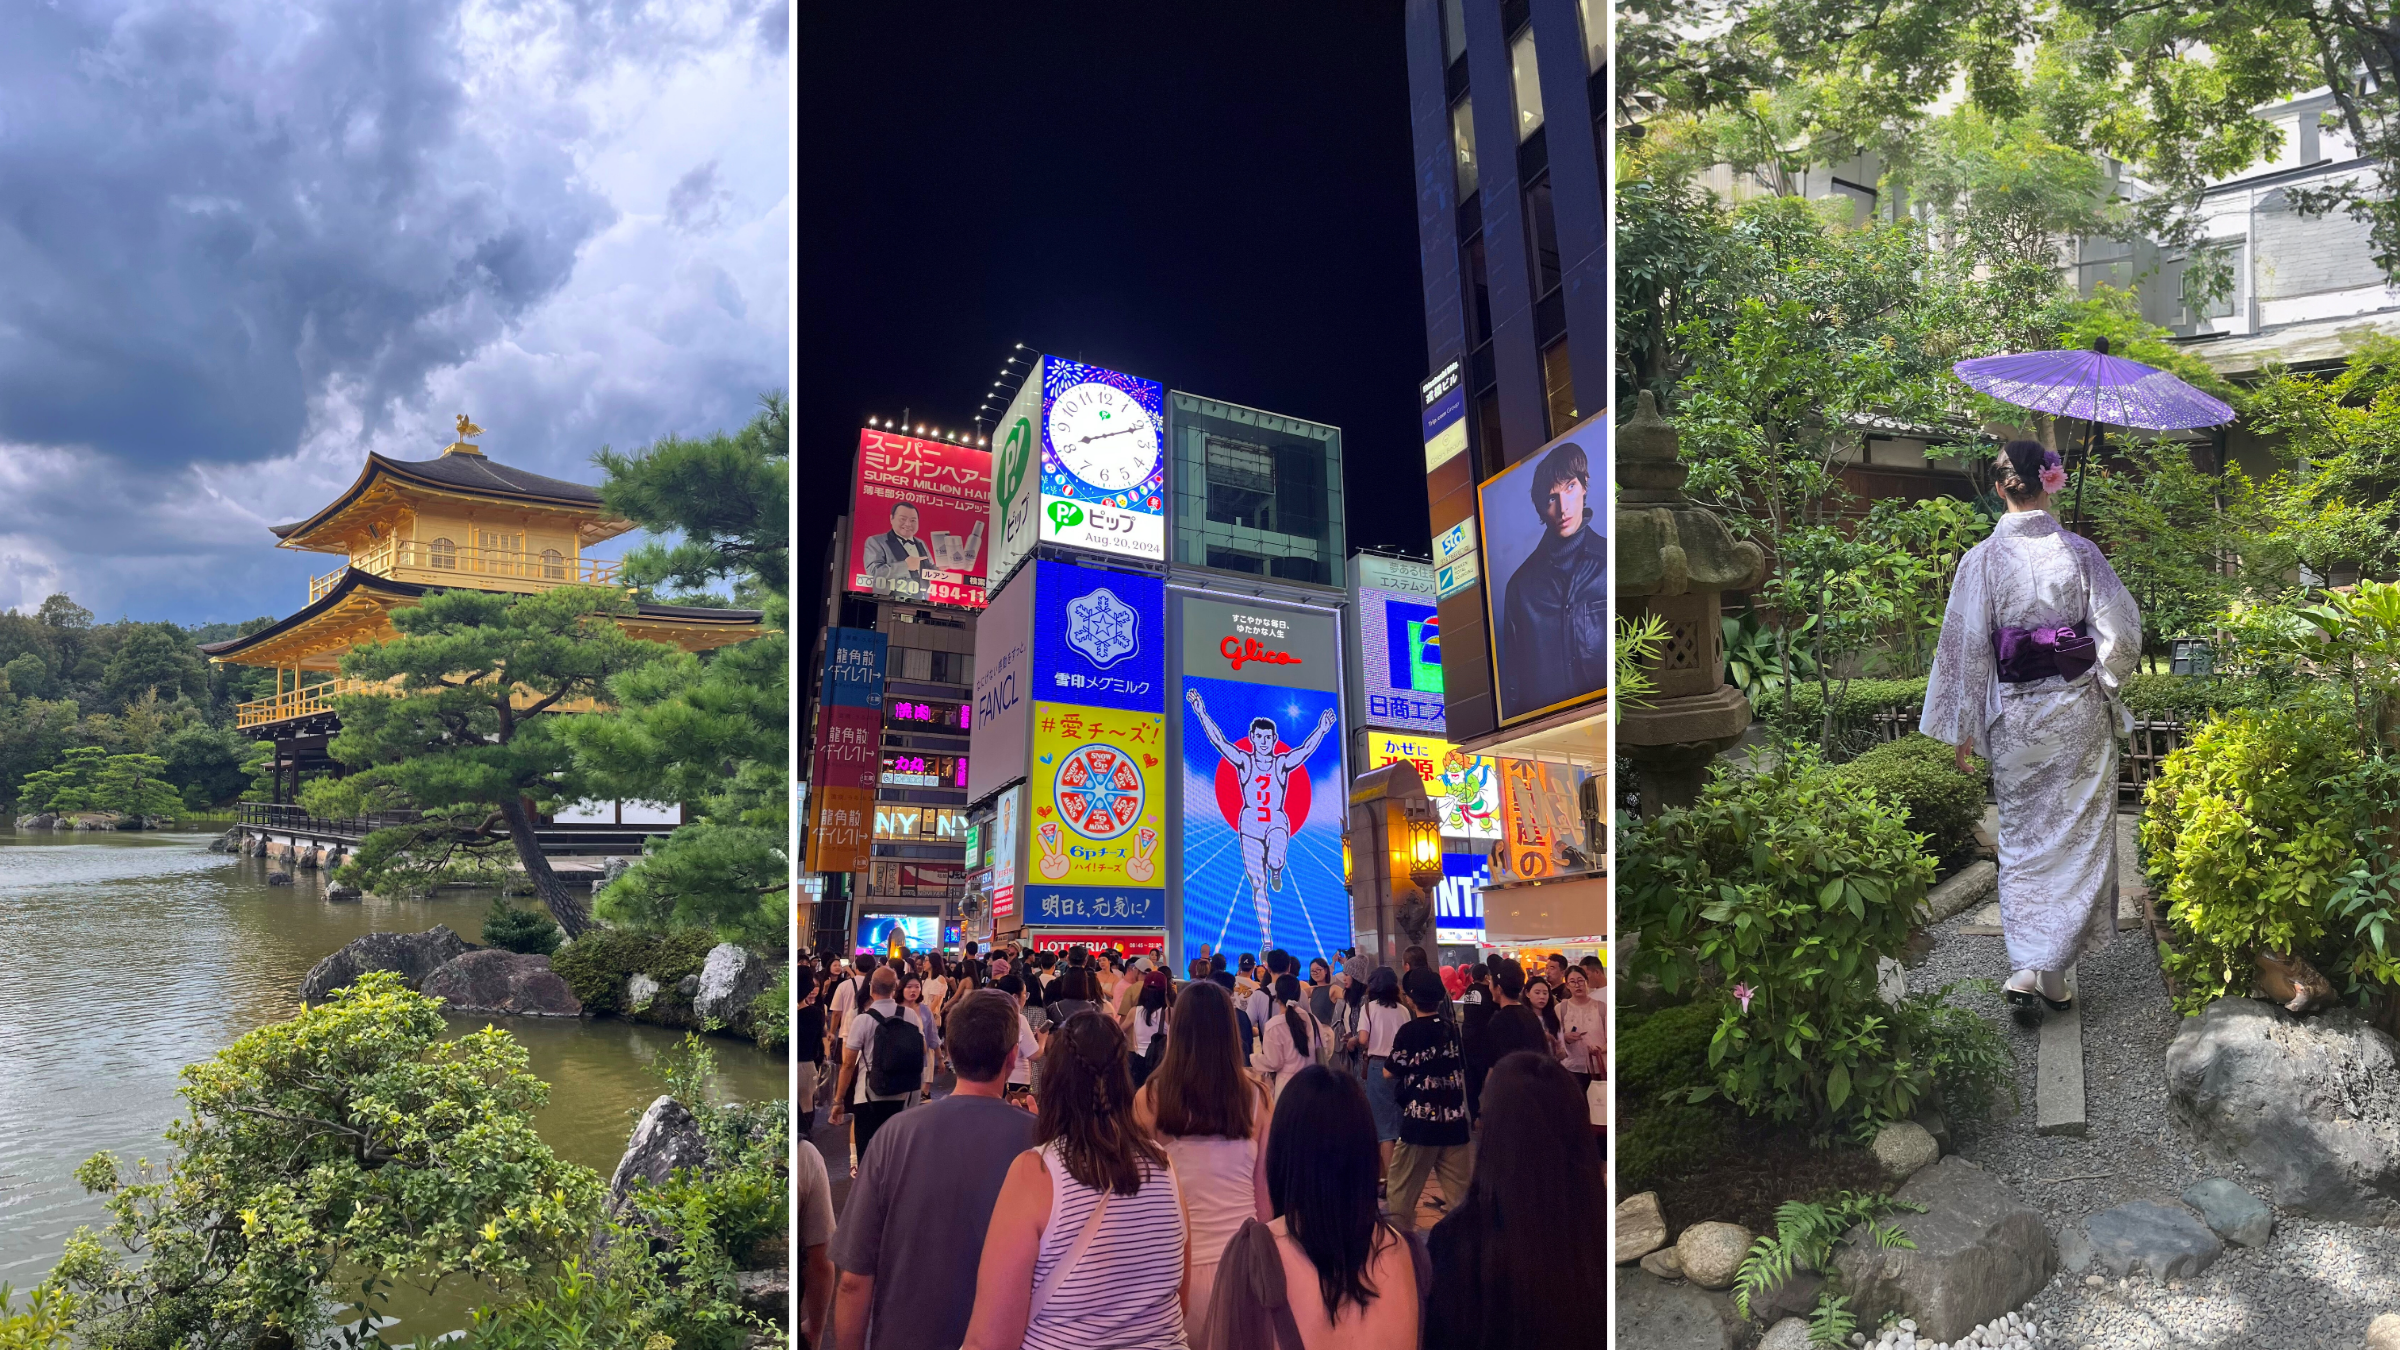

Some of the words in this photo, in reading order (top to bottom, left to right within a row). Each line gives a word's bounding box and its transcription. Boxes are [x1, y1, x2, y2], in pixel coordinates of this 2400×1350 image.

[1079, 391, 1093, 406] 11
[1098, 391, 1113, 406] 12
[1121, 403, 1129, 413] 1
[1062, 400, 1078, 418] 10
[1057, 422, 1071, 433] 9
[866, 433, 941, 459] スーパー
[1063, 443, 1077, 454] 8
[1137, 440, 1150, 449] 3
[865, 451, 992, 484] ミリオンヘアー
[1080, 459, 1092, 470] 7
[1133, 456, 1145, 468] 4
[1099, 468, 1109, 481] 6
[1119, 466, 1130, 480] 5
[864, 470, 909, 487] SUPER
[913, 480, 961, 496] MILLION
[1007, 492, 1030, 542] ピップ
[1089, 509, 1136, 533] ピップ
[1085, 532, 1112, 547] Aug.
[1113, 537, 1131, 550] 20,
[1131, 540, 1160, 553] 2024
[1444, 531, 1463, 551] sta
[924, 568, 949, 580] ルアン
[1232, 614, 1290, 630] すこやかな毎日、
[1236, 624, 1285, 639] ゆたかな人生
[836, 647, 876, 666] 龍角散
[1220, 635, 1303, 671] Glico
[1054, 672, 1150, 695] 雪印メグミルク
[978, 670, 1019, 730] FANCL
[1370, 694, 1446, 721] 日商エス
[895, 701, 931, 720] 焼肉
[829, 726, 869, 744] 龍角散
[1090, 752, 1112, 760] SNOW
[1384, 739, 1429, 757] かぜに
[894, 755, 925, 773] 力丸
[1064, 761, 1079, 782] SNOW
[1122, 765, 1136, 786] SNOW
[1062, 797, 1078, 818] SNOW
[1255, 773, 1272, 823] グリコ
[821, 808, 862, 827] 龍角散
[1121, 801, 1136, 822] SNOW
[875, 811, 919, 835] NY
